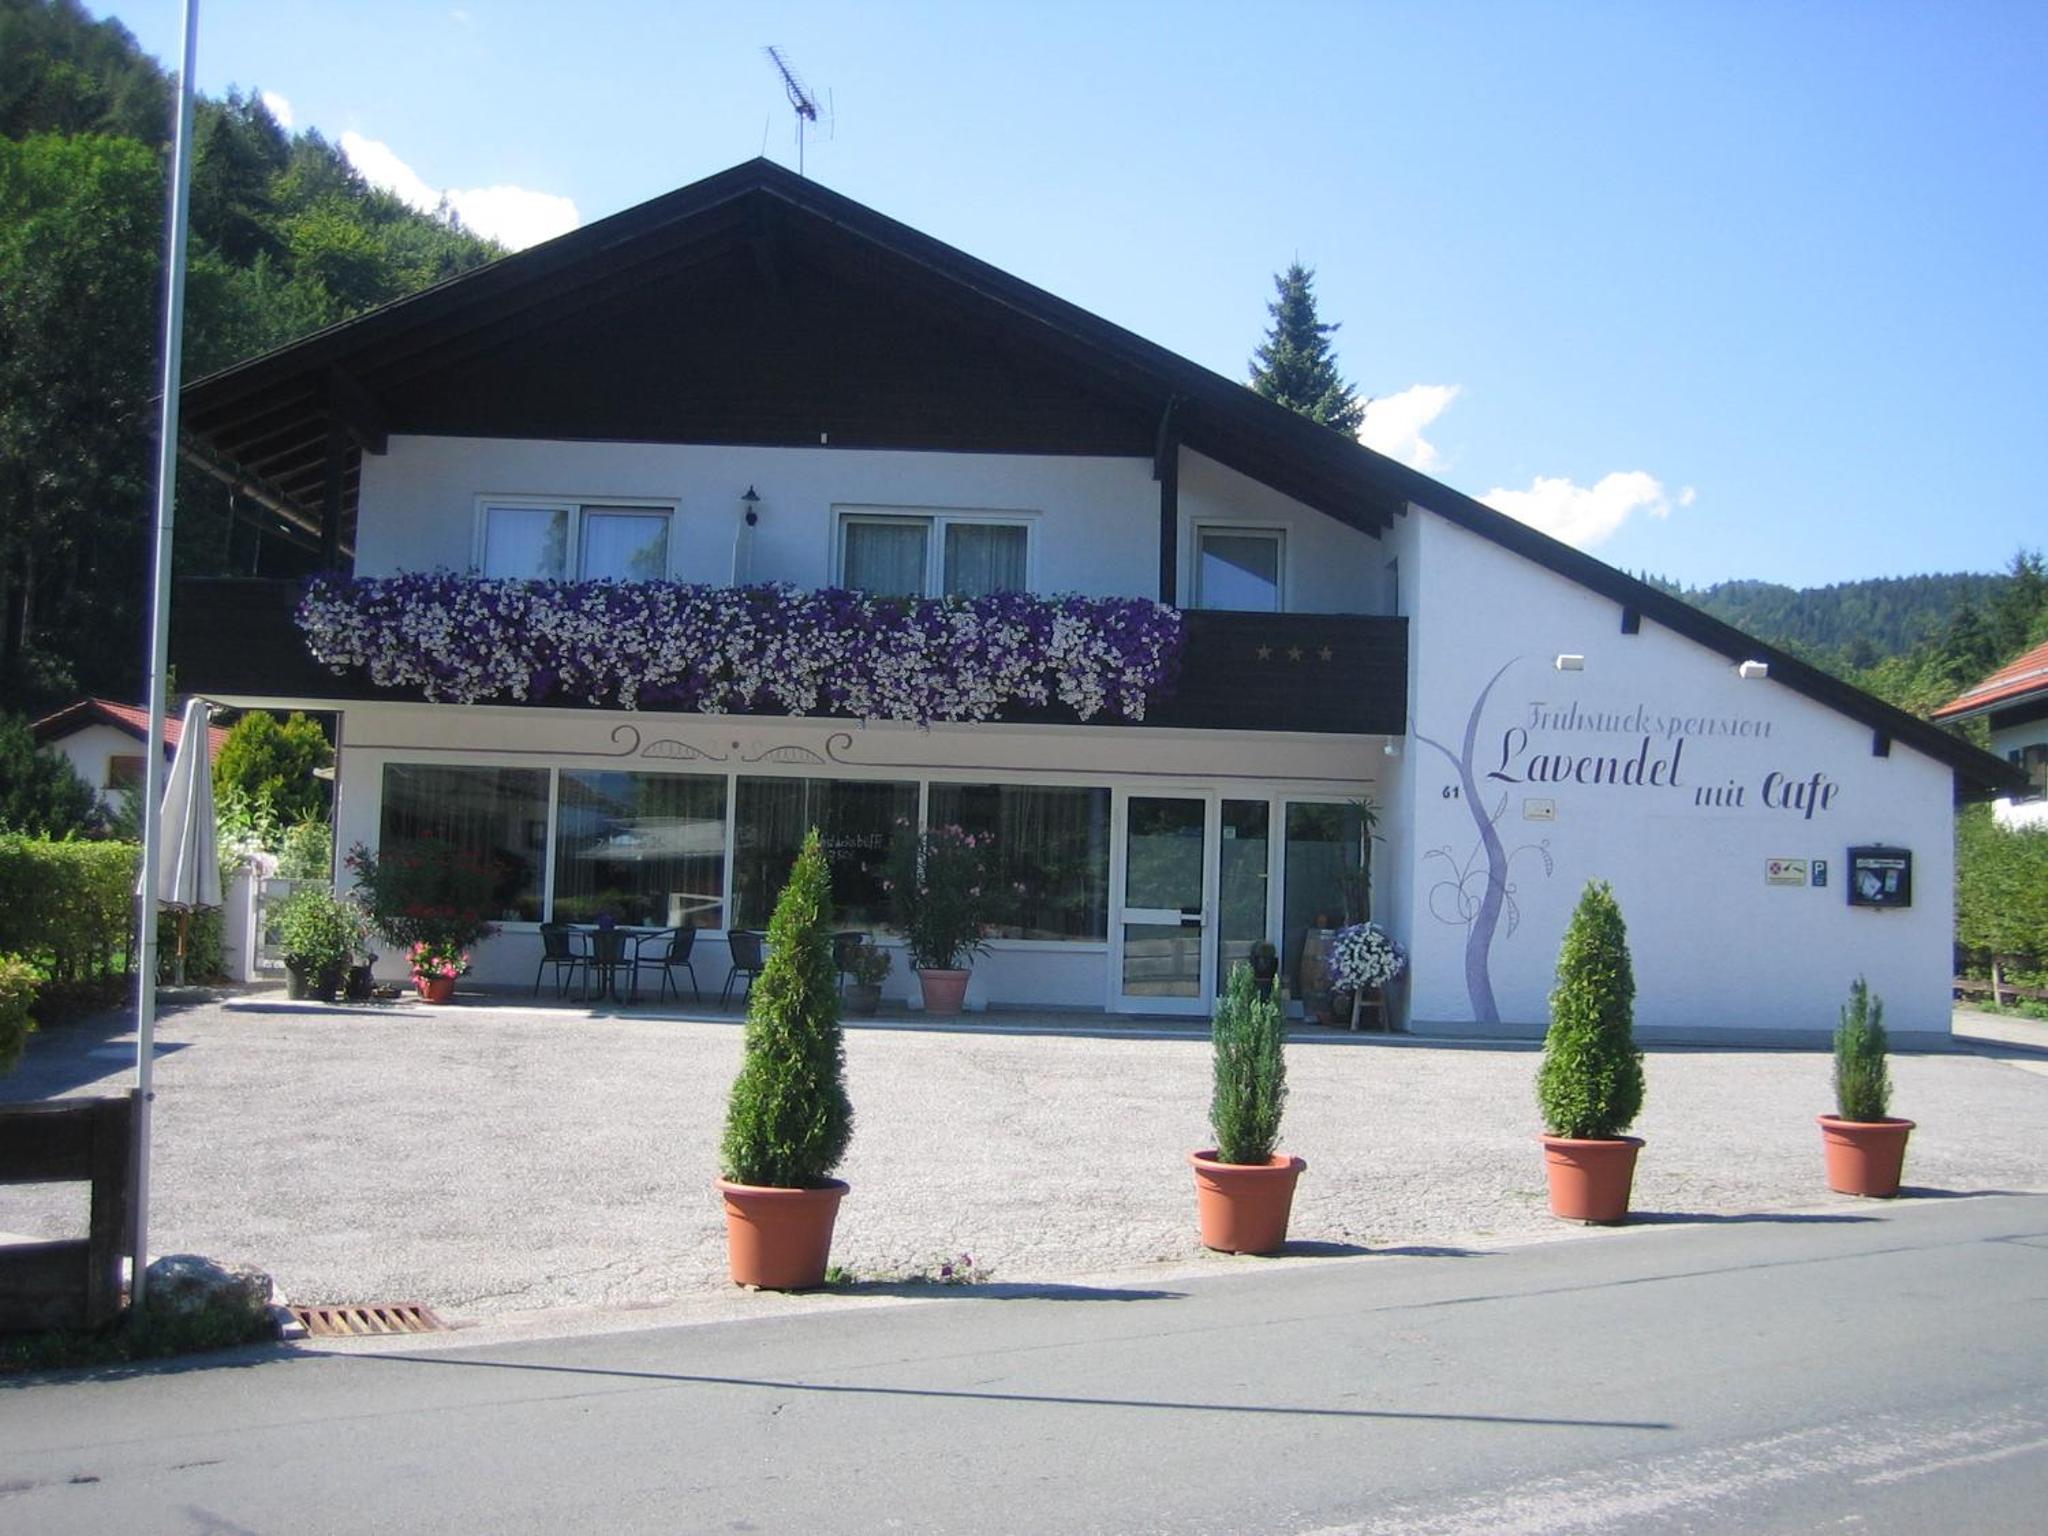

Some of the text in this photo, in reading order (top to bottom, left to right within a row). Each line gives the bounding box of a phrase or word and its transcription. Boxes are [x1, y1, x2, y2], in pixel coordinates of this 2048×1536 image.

[1487, 727, 1685, 787] Lavendel
[1694, 779, 1745, 808] mit
[1442, 785, 1459, 799] 61
[1815, 862, 1825, 876] P
